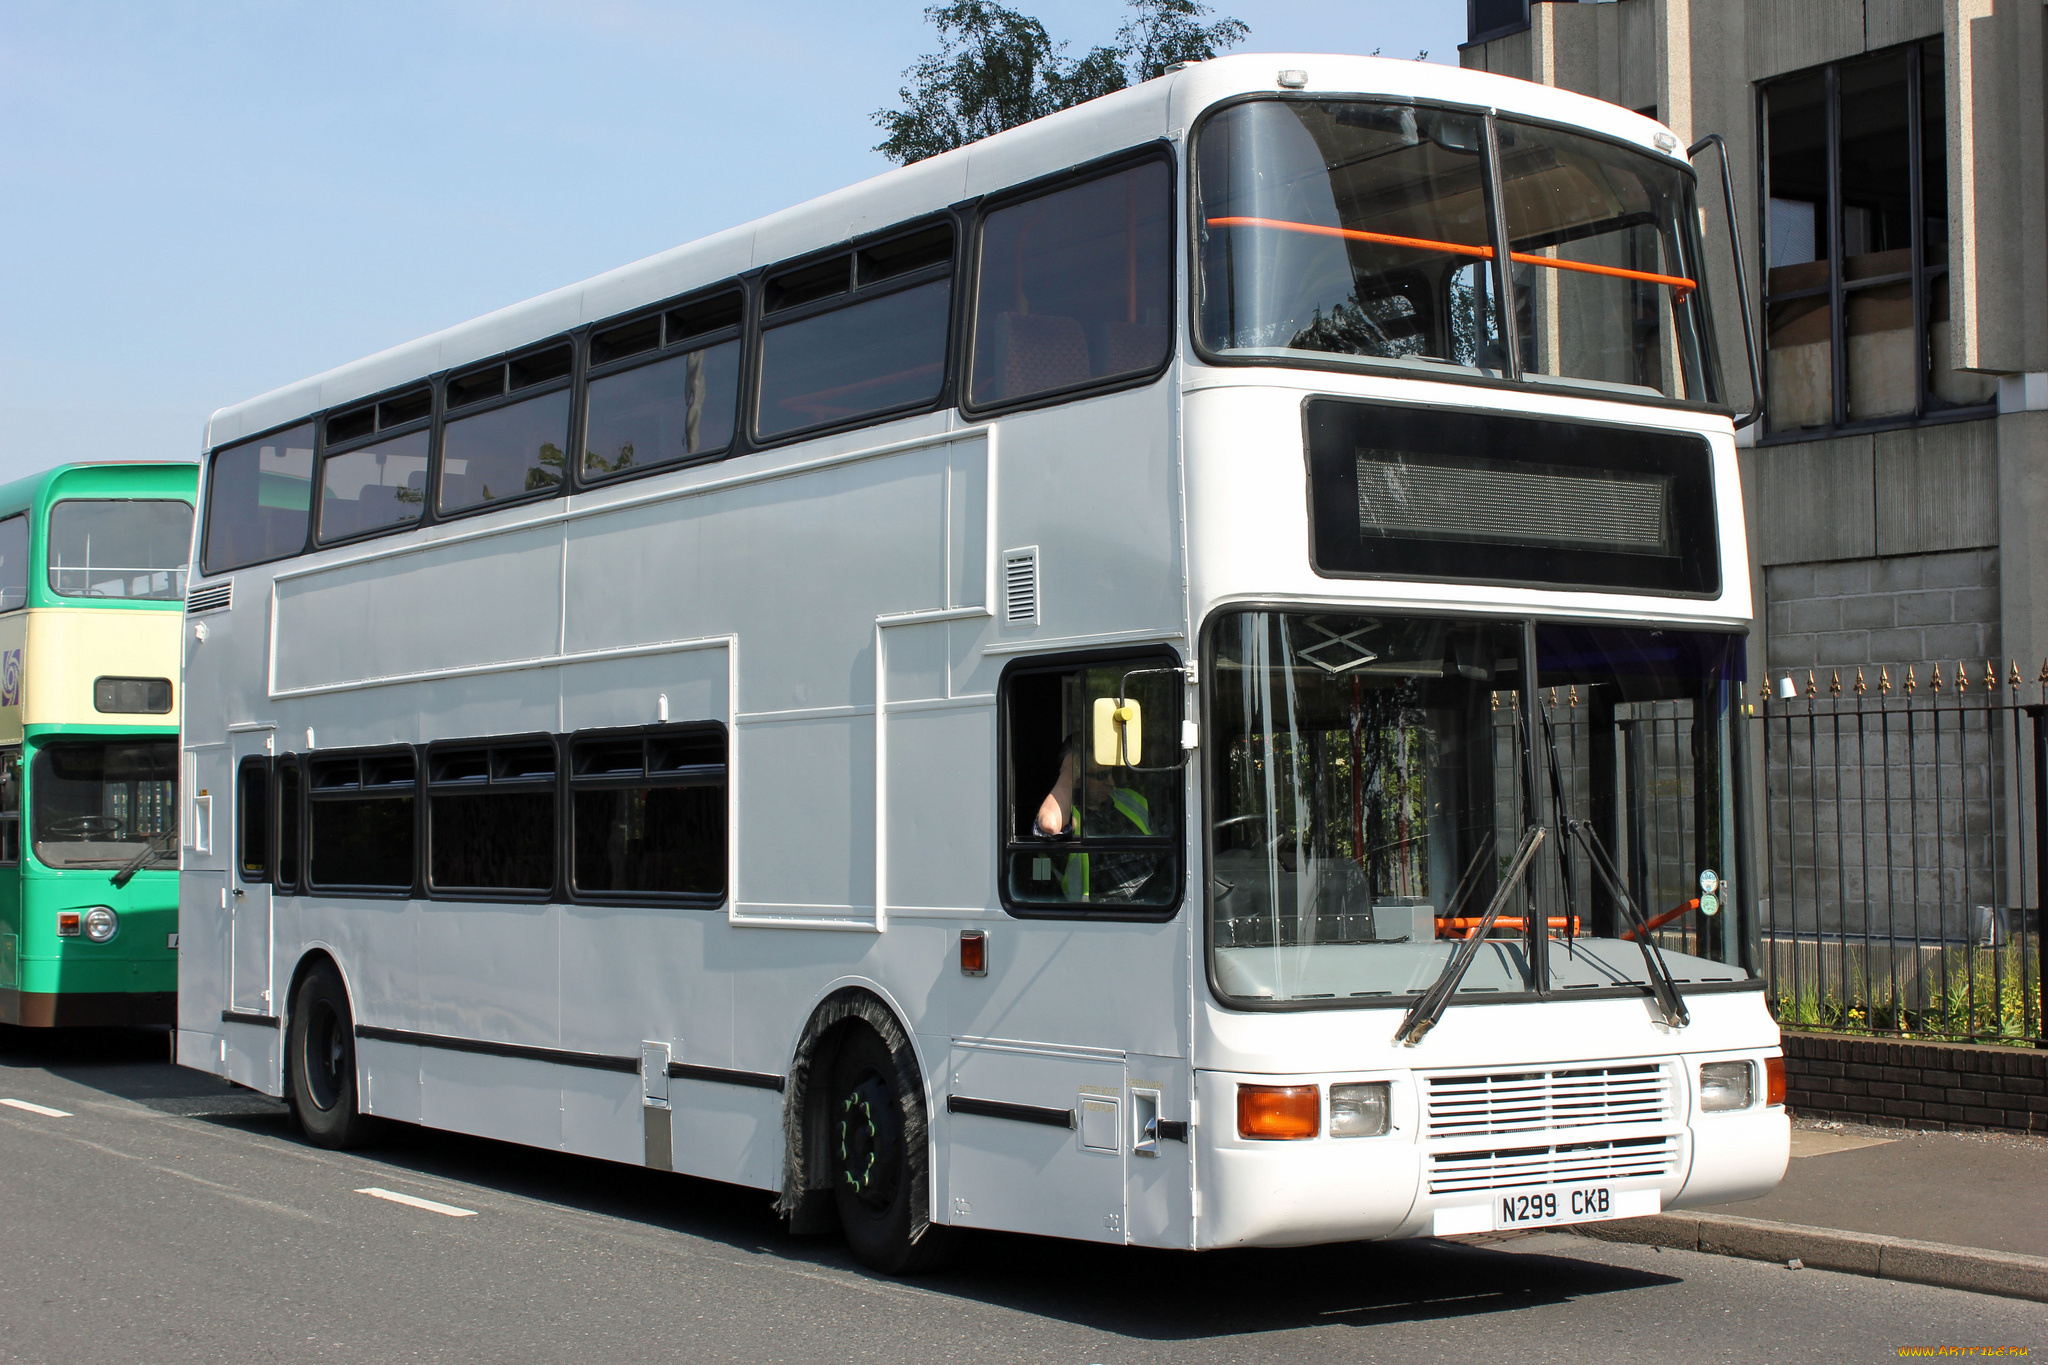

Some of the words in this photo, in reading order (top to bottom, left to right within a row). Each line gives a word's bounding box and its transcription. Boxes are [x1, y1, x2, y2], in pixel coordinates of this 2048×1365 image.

[1126, 1078, 1146, 1088] SCREEN
[1147, 1080, 1164, 1089] WASH
[1079, 1084, 1100, 1094] BATTERY
[1101, 1087, 1119, 1096] BOOST
[1503, 1193, 1556, 1222] N299
[1571, 1188, 1609, 1215] CKB
